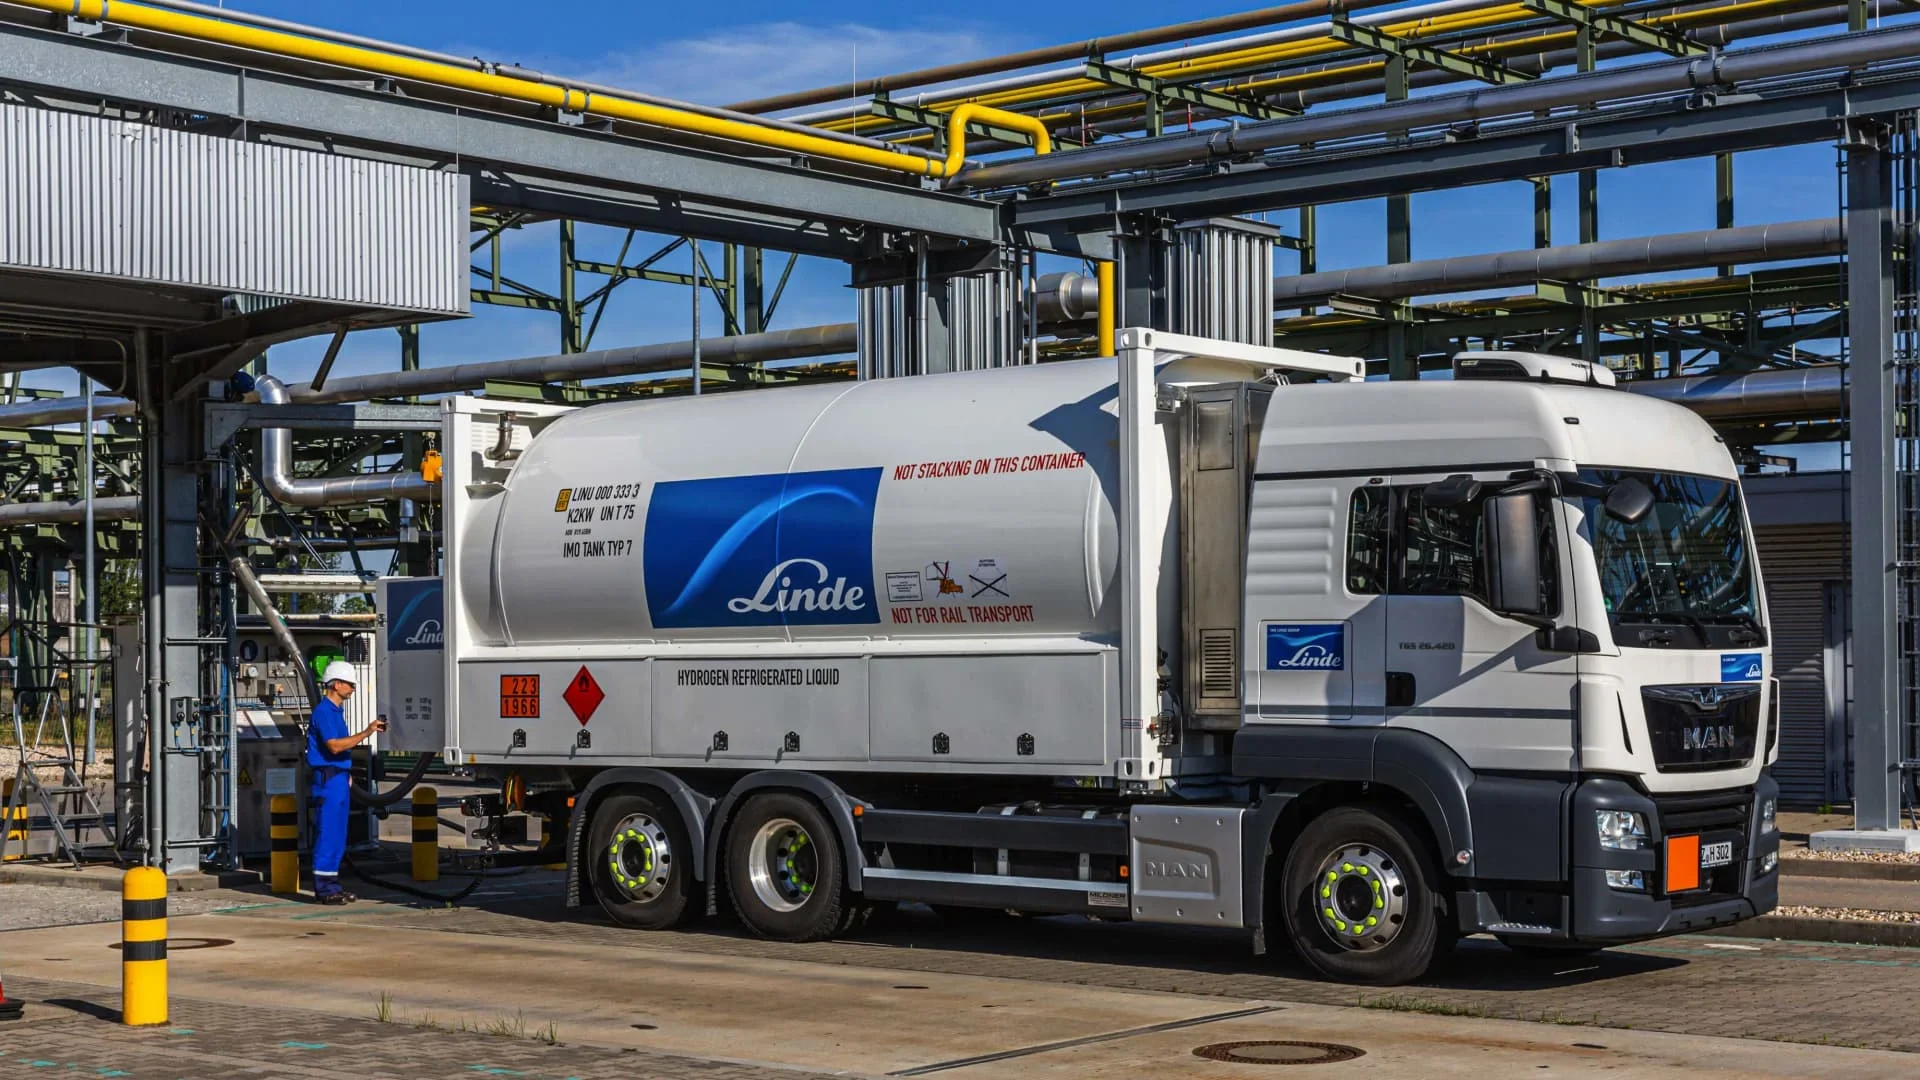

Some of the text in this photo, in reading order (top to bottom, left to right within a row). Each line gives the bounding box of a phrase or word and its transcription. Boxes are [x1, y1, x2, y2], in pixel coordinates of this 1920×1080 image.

[894, 452, 1086, 480] NOT STACKING ON THIS CONTAINER
[572, 483, 640, 501] LINU 000 333 3
[567, 504, 635, 523] K2KW UN T 75
[563, 540, 632, 558] IMO TANK TYP 7
[728, 558, 866, 612] Linde
[891, 605, 1034, 624] NOT FOR RAIL TRANSPORT
[1279, 645, 1342, 667] Linde
[512, 678, 537, 695] 223
[678, 668, 839, 686] HYDROGEN REFRIGERATED LIQUID
[504, 699, 537, 715] 1966
[1683, 725, 1735, 750] MAN
[1144, 860, 1208, 879] MAN
